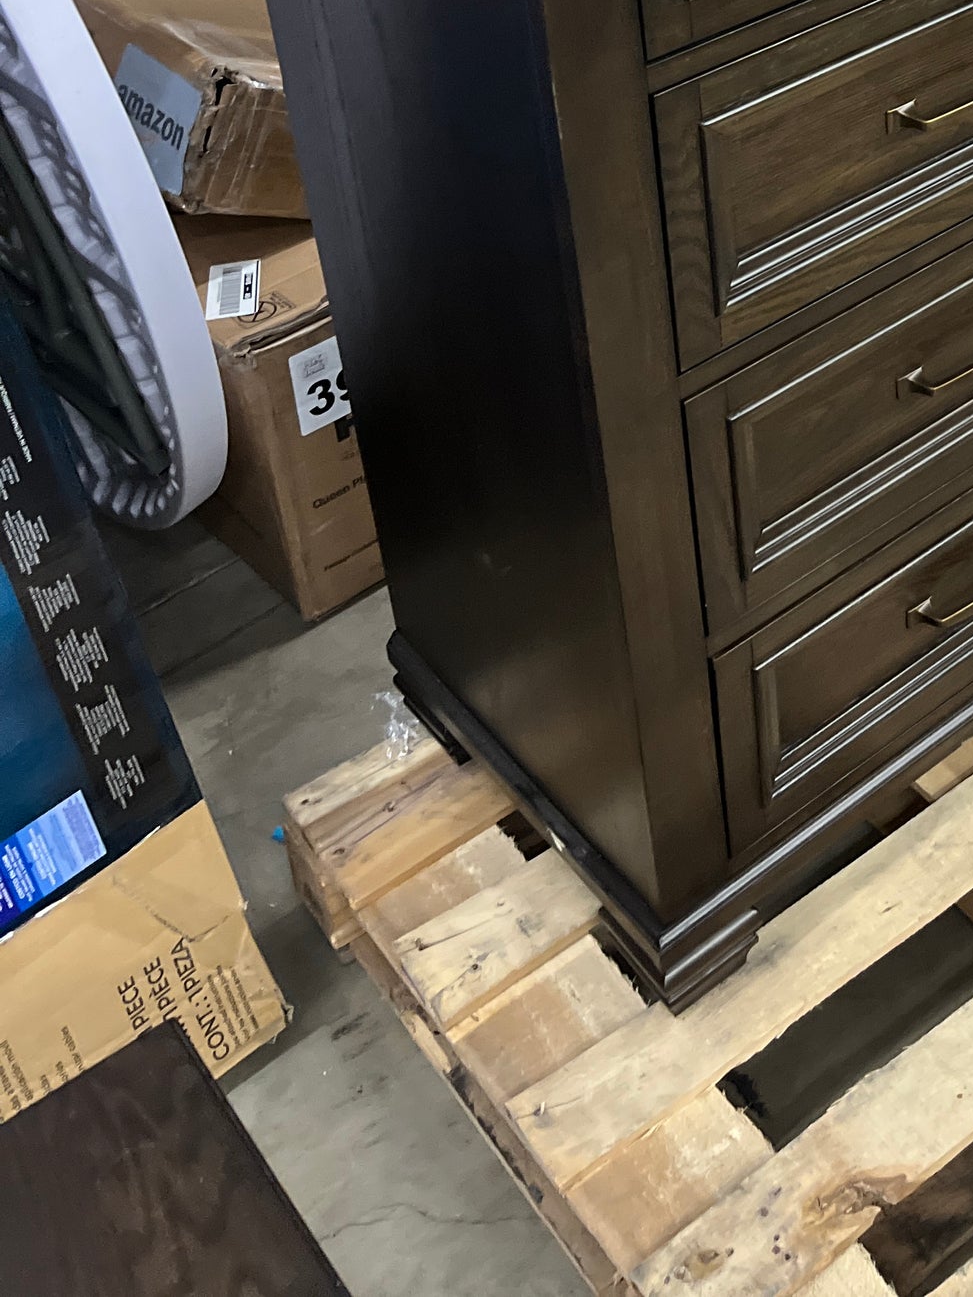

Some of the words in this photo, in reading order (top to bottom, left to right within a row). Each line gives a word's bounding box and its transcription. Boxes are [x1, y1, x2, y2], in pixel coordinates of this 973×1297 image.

[118, 84, 184, 151] amazon
[307, 370, 350, 416] 39
[312, 484, 351, 509] Queen
[143, 956, 175, 1012] PIÈCE
[171, 937, 201, 993] PIEZA
[117, 975, 149, 1031] PIECE
